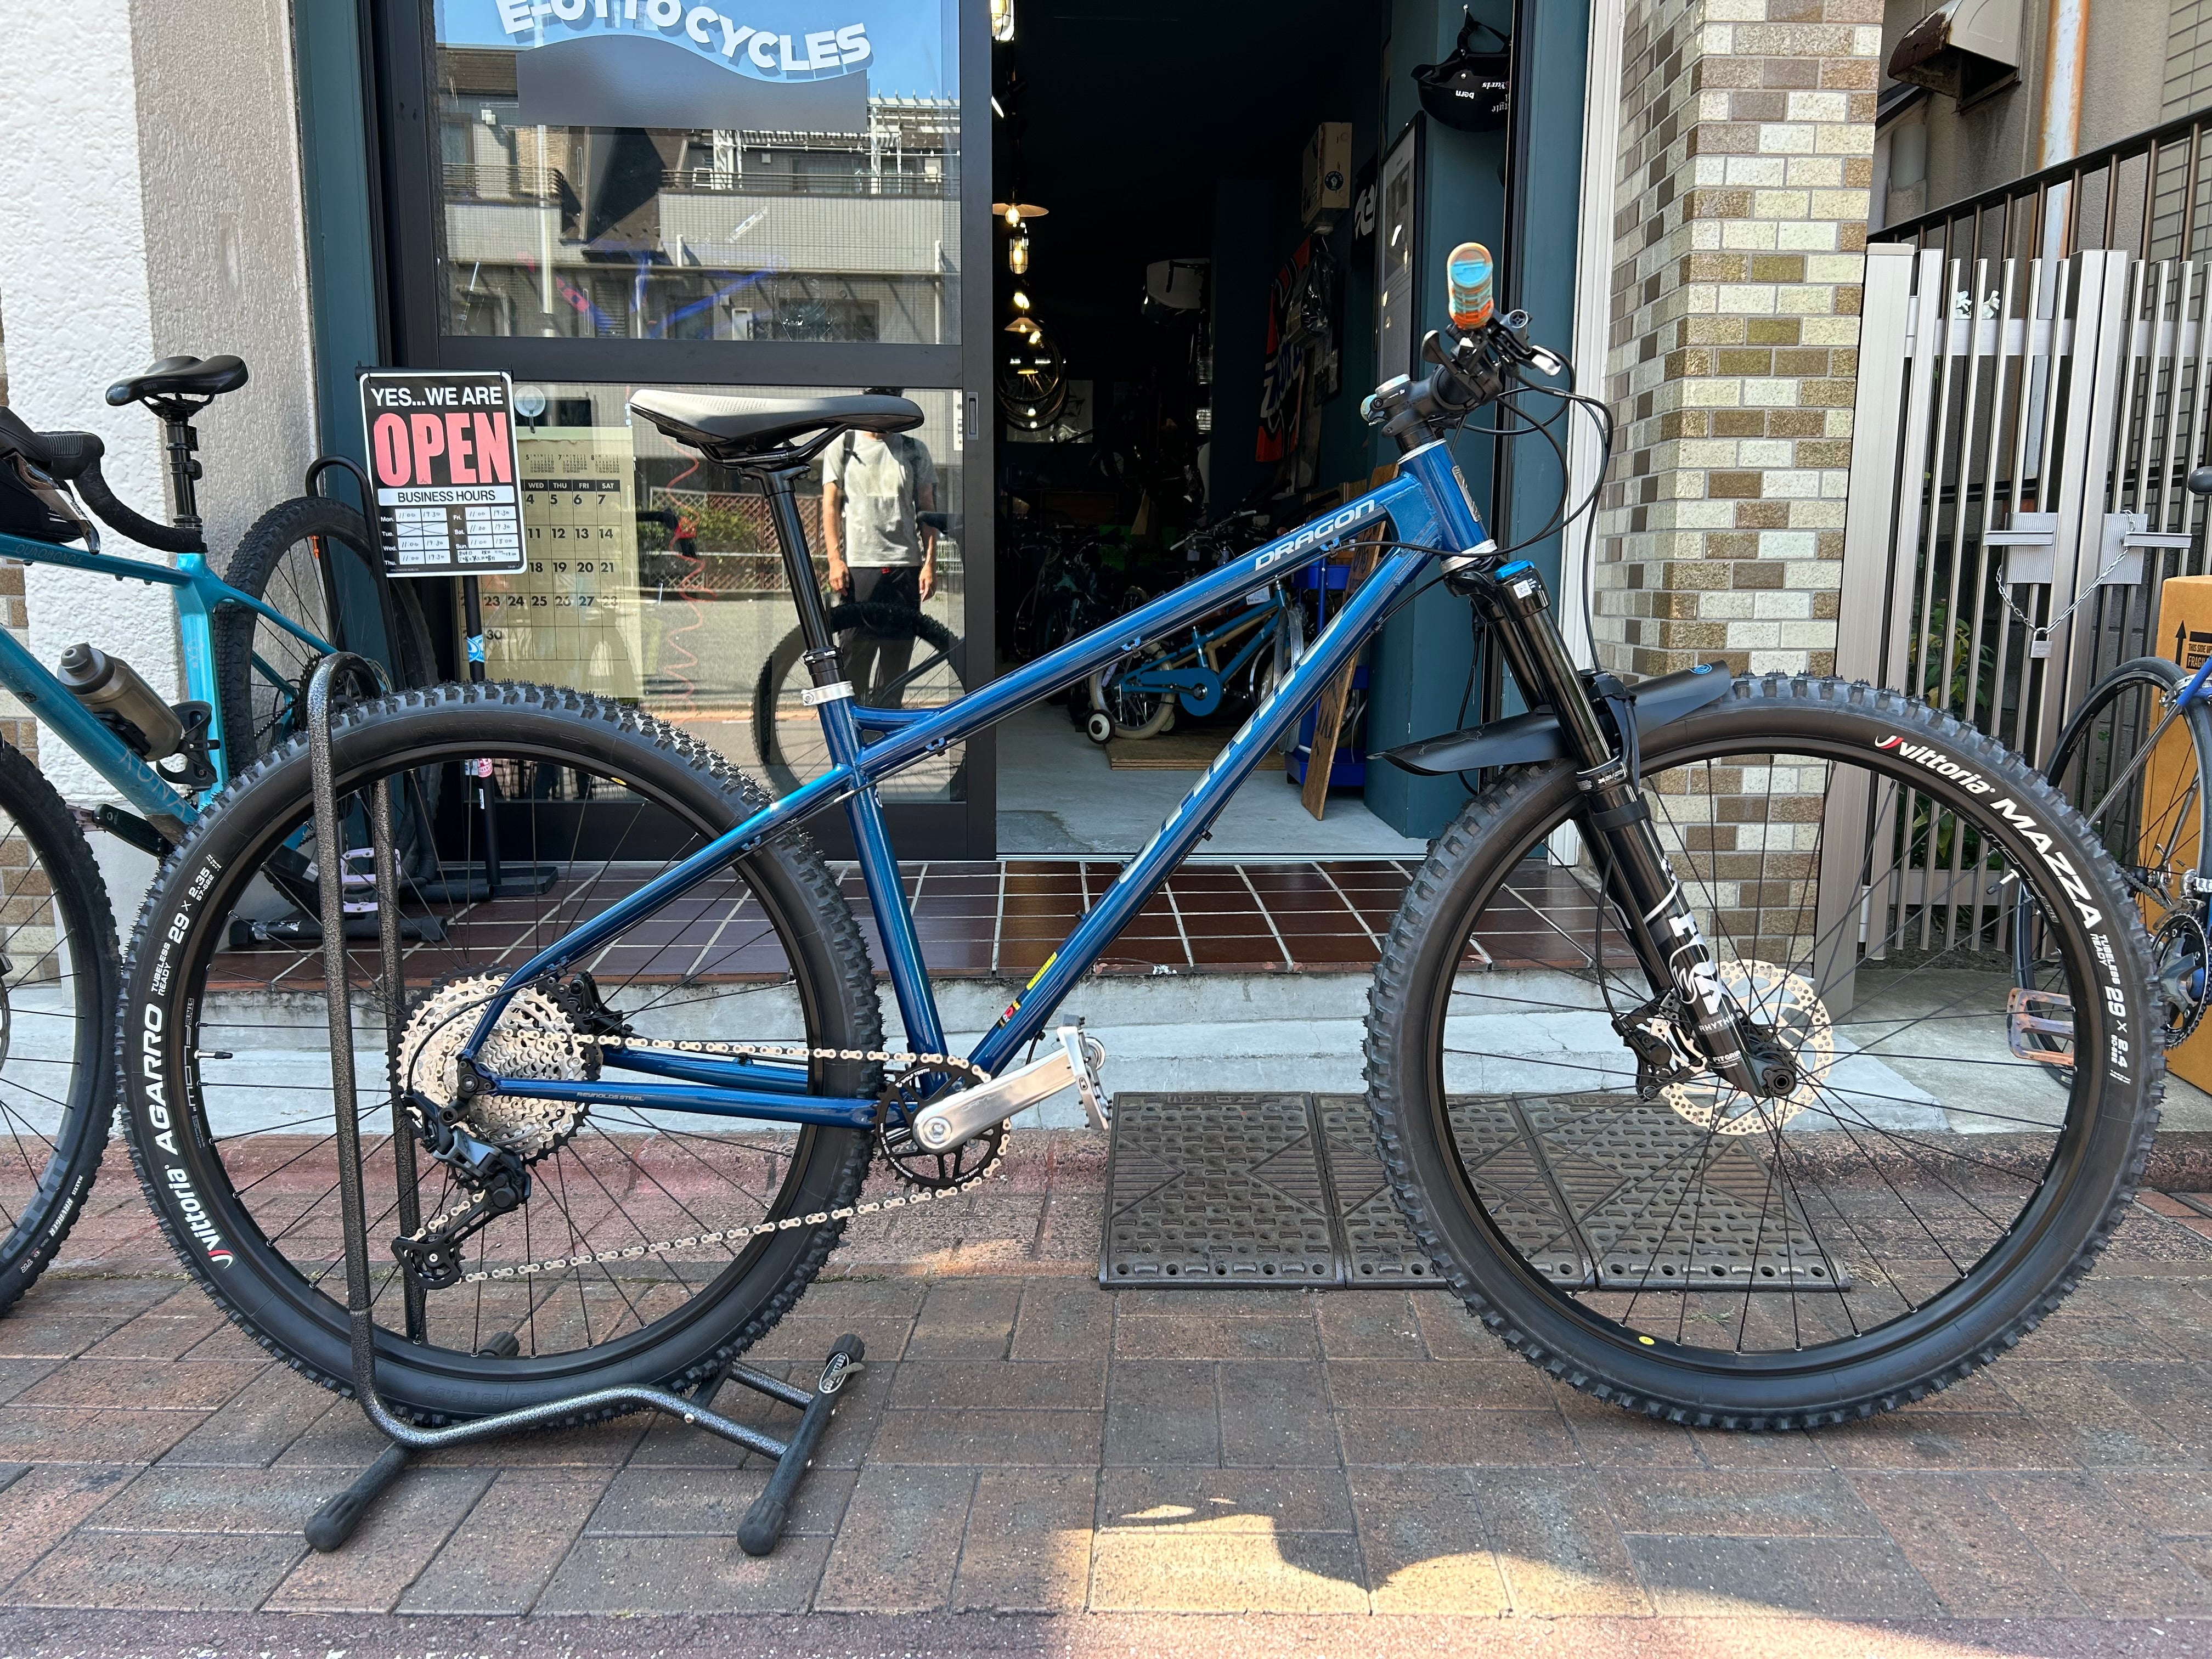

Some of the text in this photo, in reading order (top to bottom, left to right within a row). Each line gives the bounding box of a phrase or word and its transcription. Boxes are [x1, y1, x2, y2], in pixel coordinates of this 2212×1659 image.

[686, 5, 872, 71] CYCLES
[1455, 90, 1475, 99] bern
[461, 386, 504, 405] ARE
[373, 412, 512, 487] OPEN
[398, 490, 496, 503] BUSINESS HOURS
[526, 494, 606, 505] 4 5 6 7
[528, 528, 613, 539] 11 12 13 14
[1255, 499, 1375, 571] DRAGON
[529, 562, 614, 573] 18 19 20 21
[484, 596, 500, 606] 23
[508, 596, 524, 606] 24
[531, 596, 548, 606] 25
[555, 596, 571, 606] 26
[578, 596, 595, 606] 27
[486, 630, 503, 640] 30
[2188, 643, 2197, 652] THIS
[2197, 644, 2206, 653] SIDE
[1898, 737, 2103, 930] vittoria MAZZA
[168, 912, 190, 944] 29
[188, 866, 211, 899] 2.35
[151, 942, 171, 992] TUBELESS
[157, 962, 171, 997] READY
[1699, 1013, 1736, 1033] RHYTHM
[2104, 986, 2126, 1017] 29
[2118, 1037, 2129, 1068] 2.4
[143, 1002, 219, 1252] vittoria AGARRO
